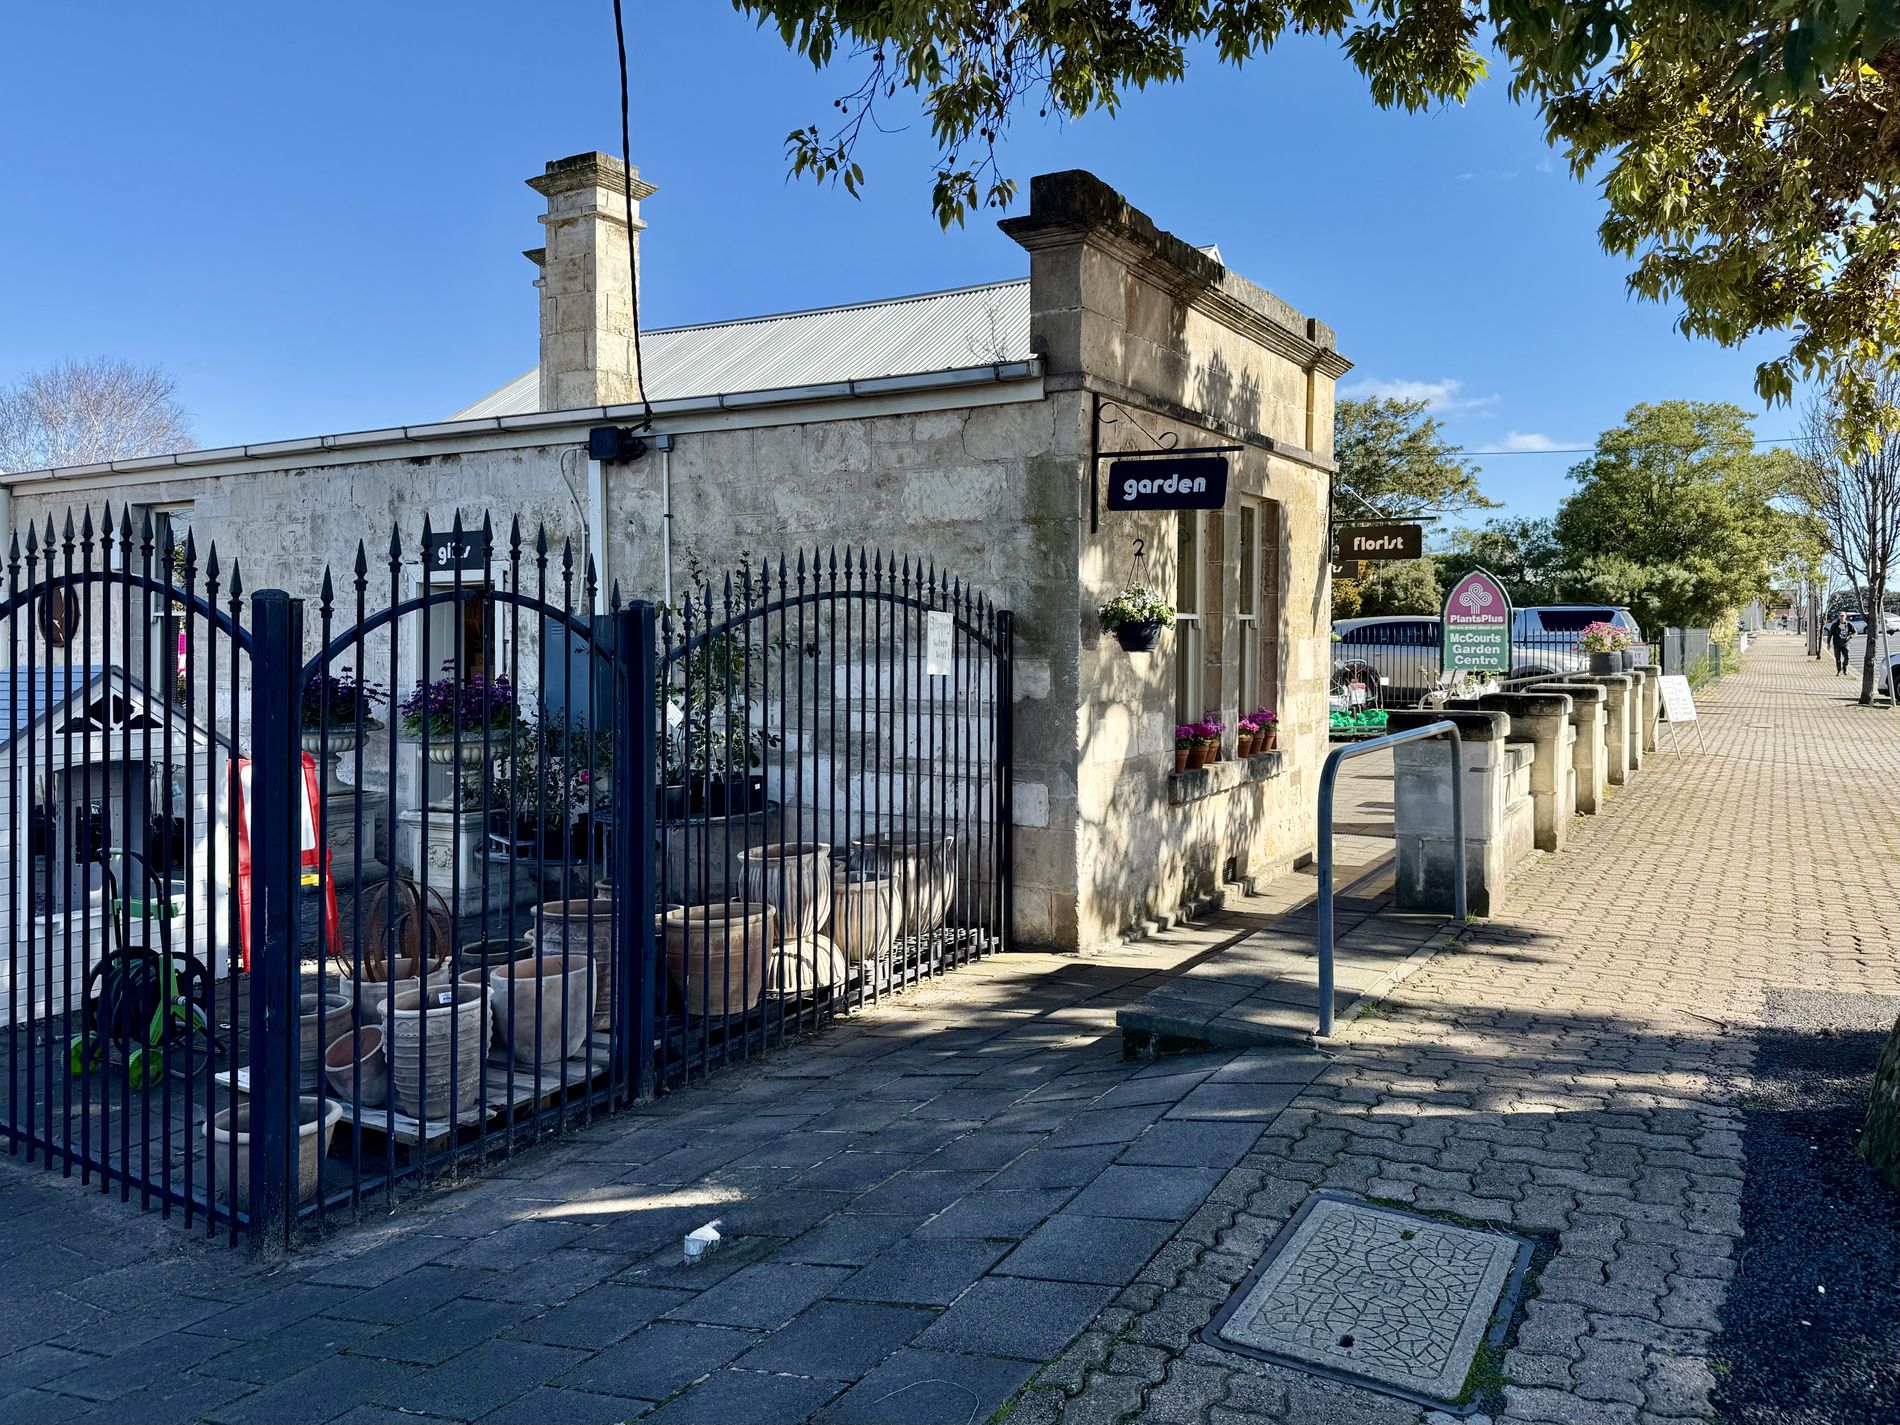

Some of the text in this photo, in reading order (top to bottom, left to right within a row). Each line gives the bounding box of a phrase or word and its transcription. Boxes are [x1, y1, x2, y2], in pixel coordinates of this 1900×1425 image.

[1123, 474, 1207, 501] garden
[1353, 536, 1404, 551] florist
[438, 542, 471, 565] gis
[1450, 614, 1504, 623] PlantsPlus
[1450, 633, 1501, 643] McCourts
[1452, 644, 1500, 654] Garden
[1455, 655, 1498, 665] Centre
